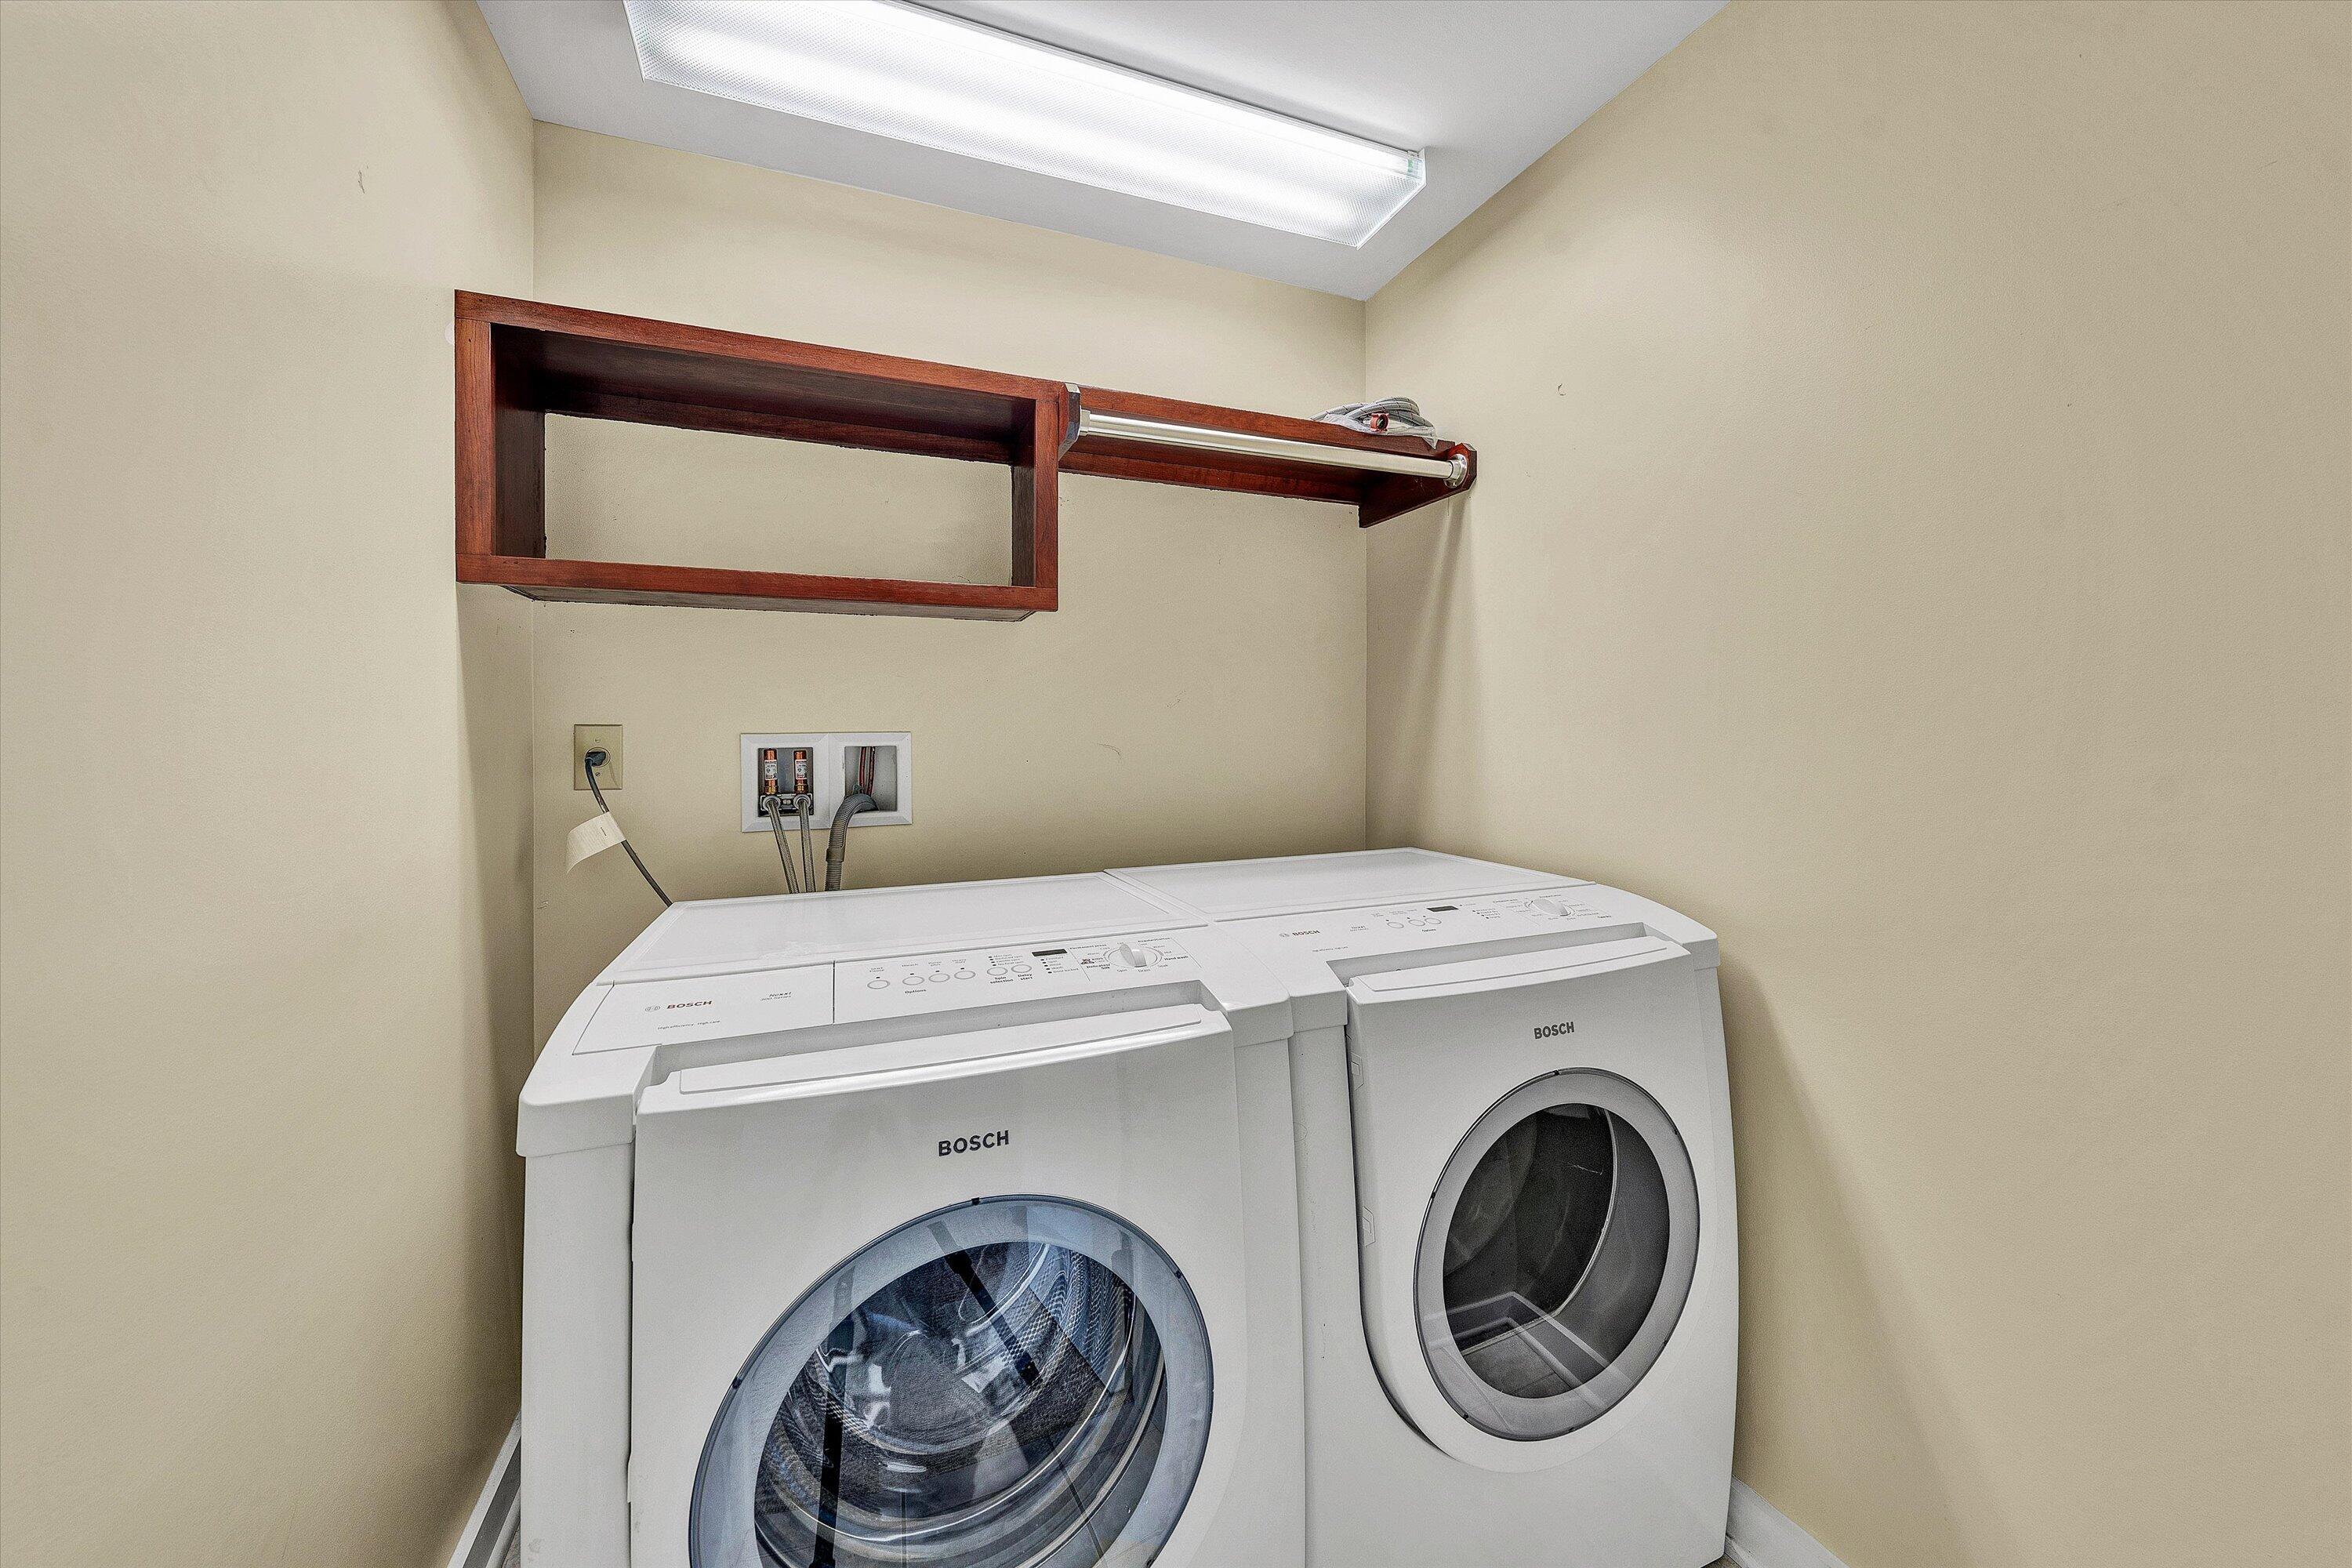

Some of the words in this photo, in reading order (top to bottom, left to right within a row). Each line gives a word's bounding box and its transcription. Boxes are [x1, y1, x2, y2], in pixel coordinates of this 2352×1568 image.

[666, 1000, 713, 1010] BOSCH
[1534, 1021, 1575, 1040] BOSCH
[938, 1129, 1010, 1157] BOSCH
